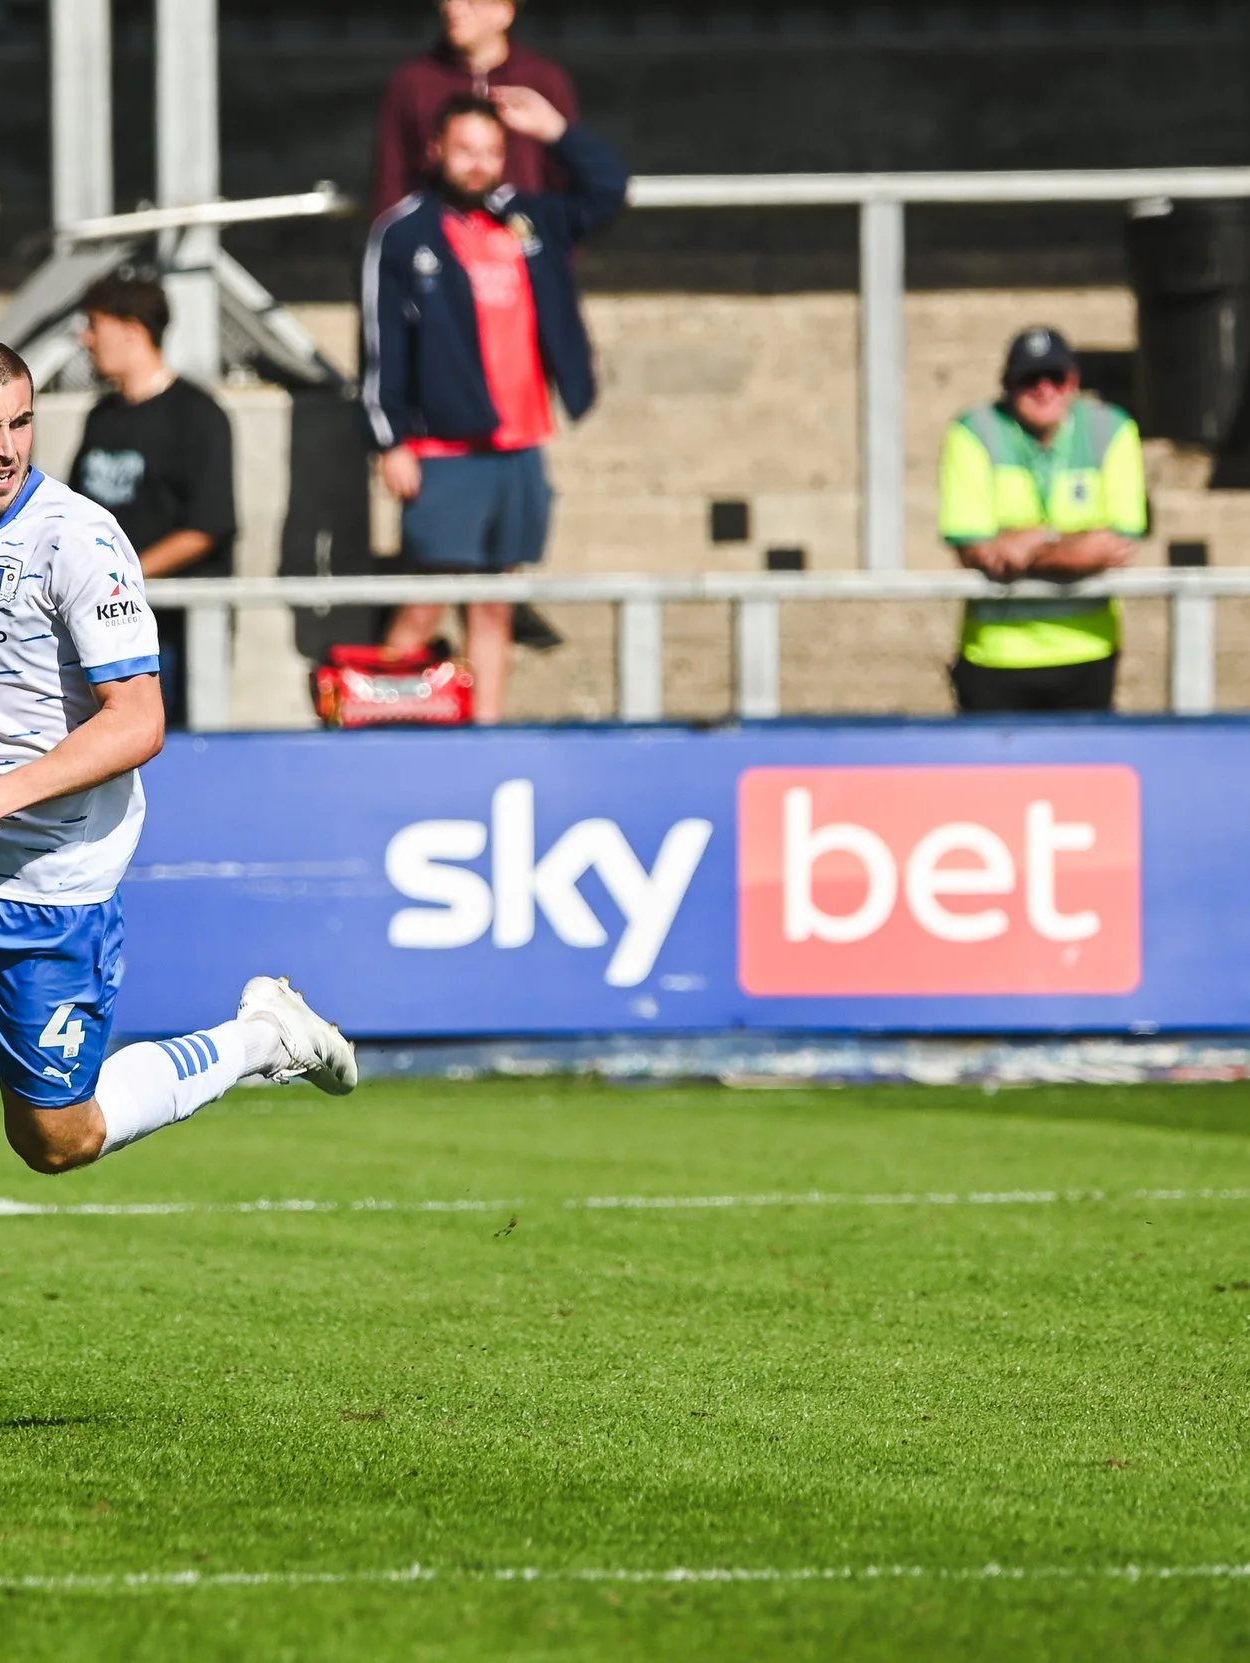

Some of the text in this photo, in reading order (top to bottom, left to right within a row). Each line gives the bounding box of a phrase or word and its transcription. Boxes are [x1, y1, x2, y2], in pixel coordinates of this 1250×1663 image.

[385, 778, 1101, 987] sky bet
[39, 1003, 86, 1058] 4
